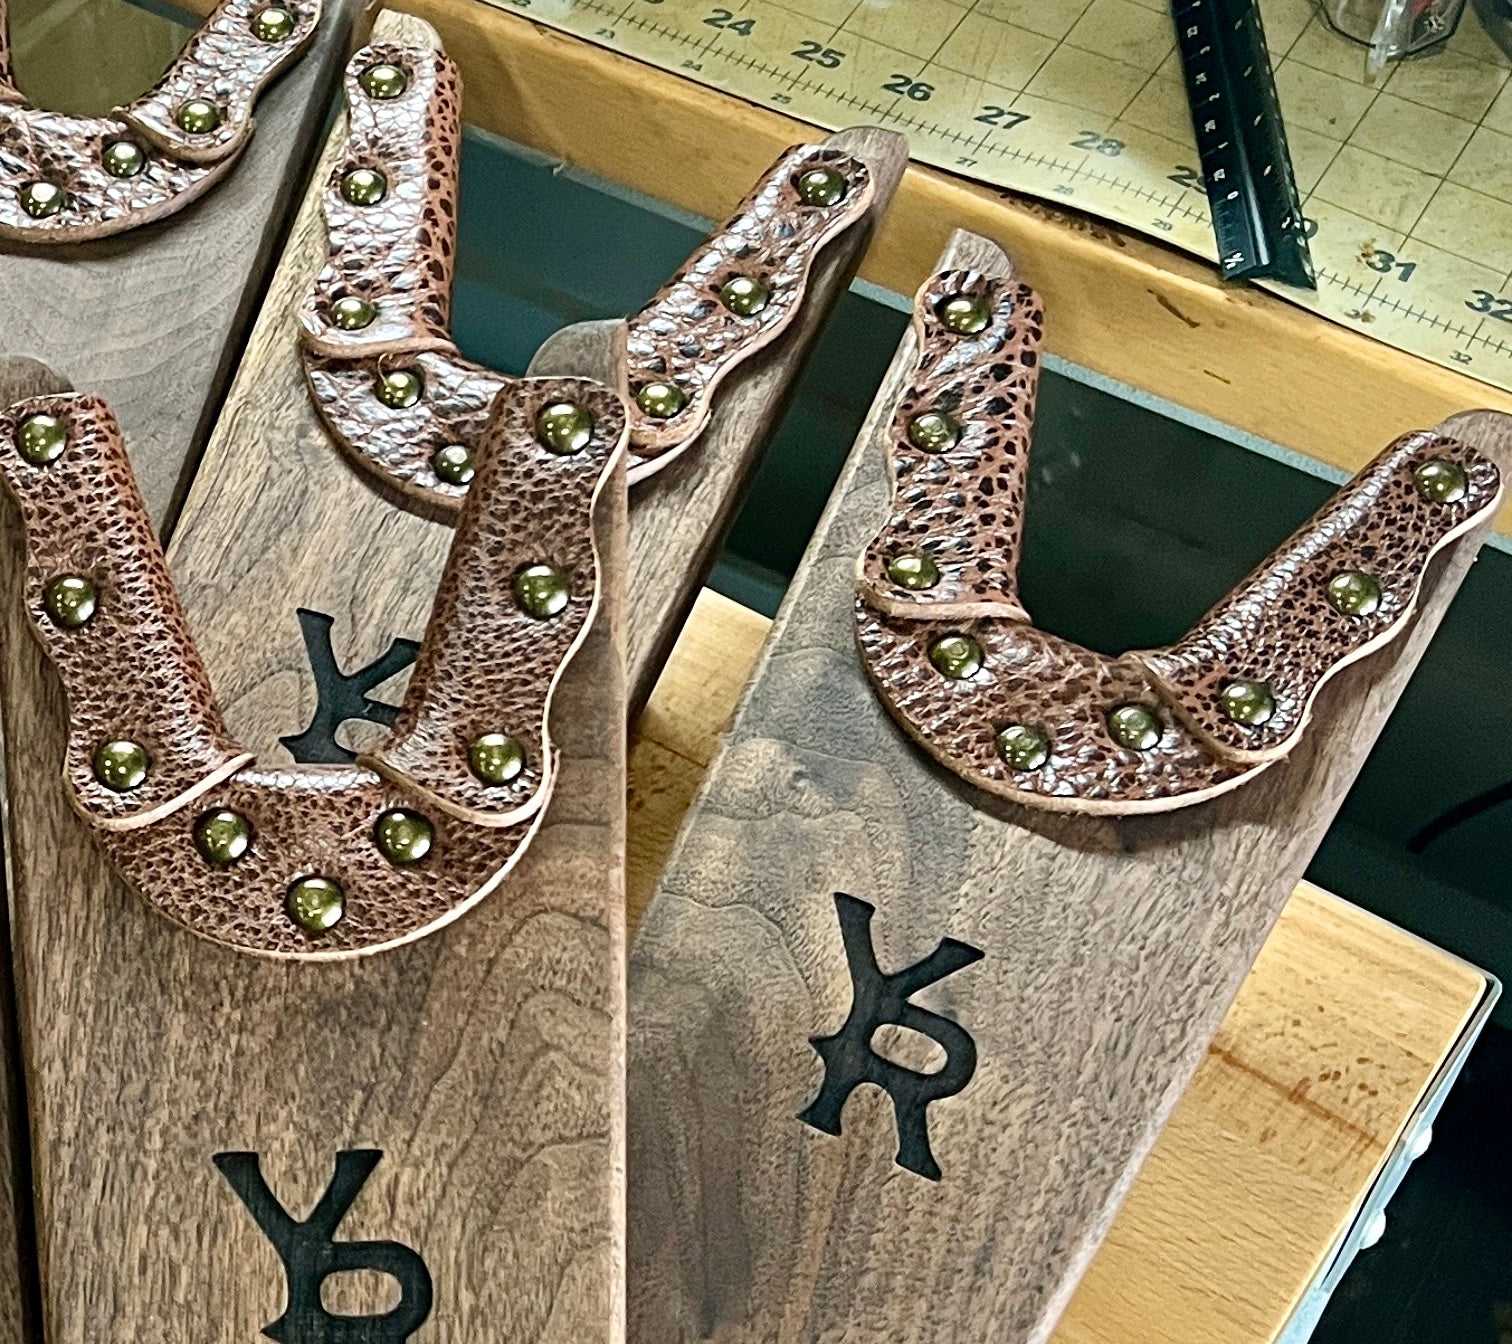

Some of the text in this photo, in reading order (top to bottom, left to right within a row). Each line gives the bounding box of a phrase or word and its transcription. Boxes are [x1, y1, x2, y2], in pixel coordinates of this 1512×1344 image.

[702, 8, 756, 37] 24
[790, 40, 846, 69] 25
[882, 74, 935, 102] 26
[973, 105, 1031, 130] 27
[1068, 130, 1126, 157] 28
[1364, 250, 1417, 283] 31
[1464, 289, 1512, 324] 32
[955, 157, 978, 167] 27
[1151, 218, 1173, 231] 29
[1449, 350, 1473, 365] 32
[797, 892, 985, 1182] YR
